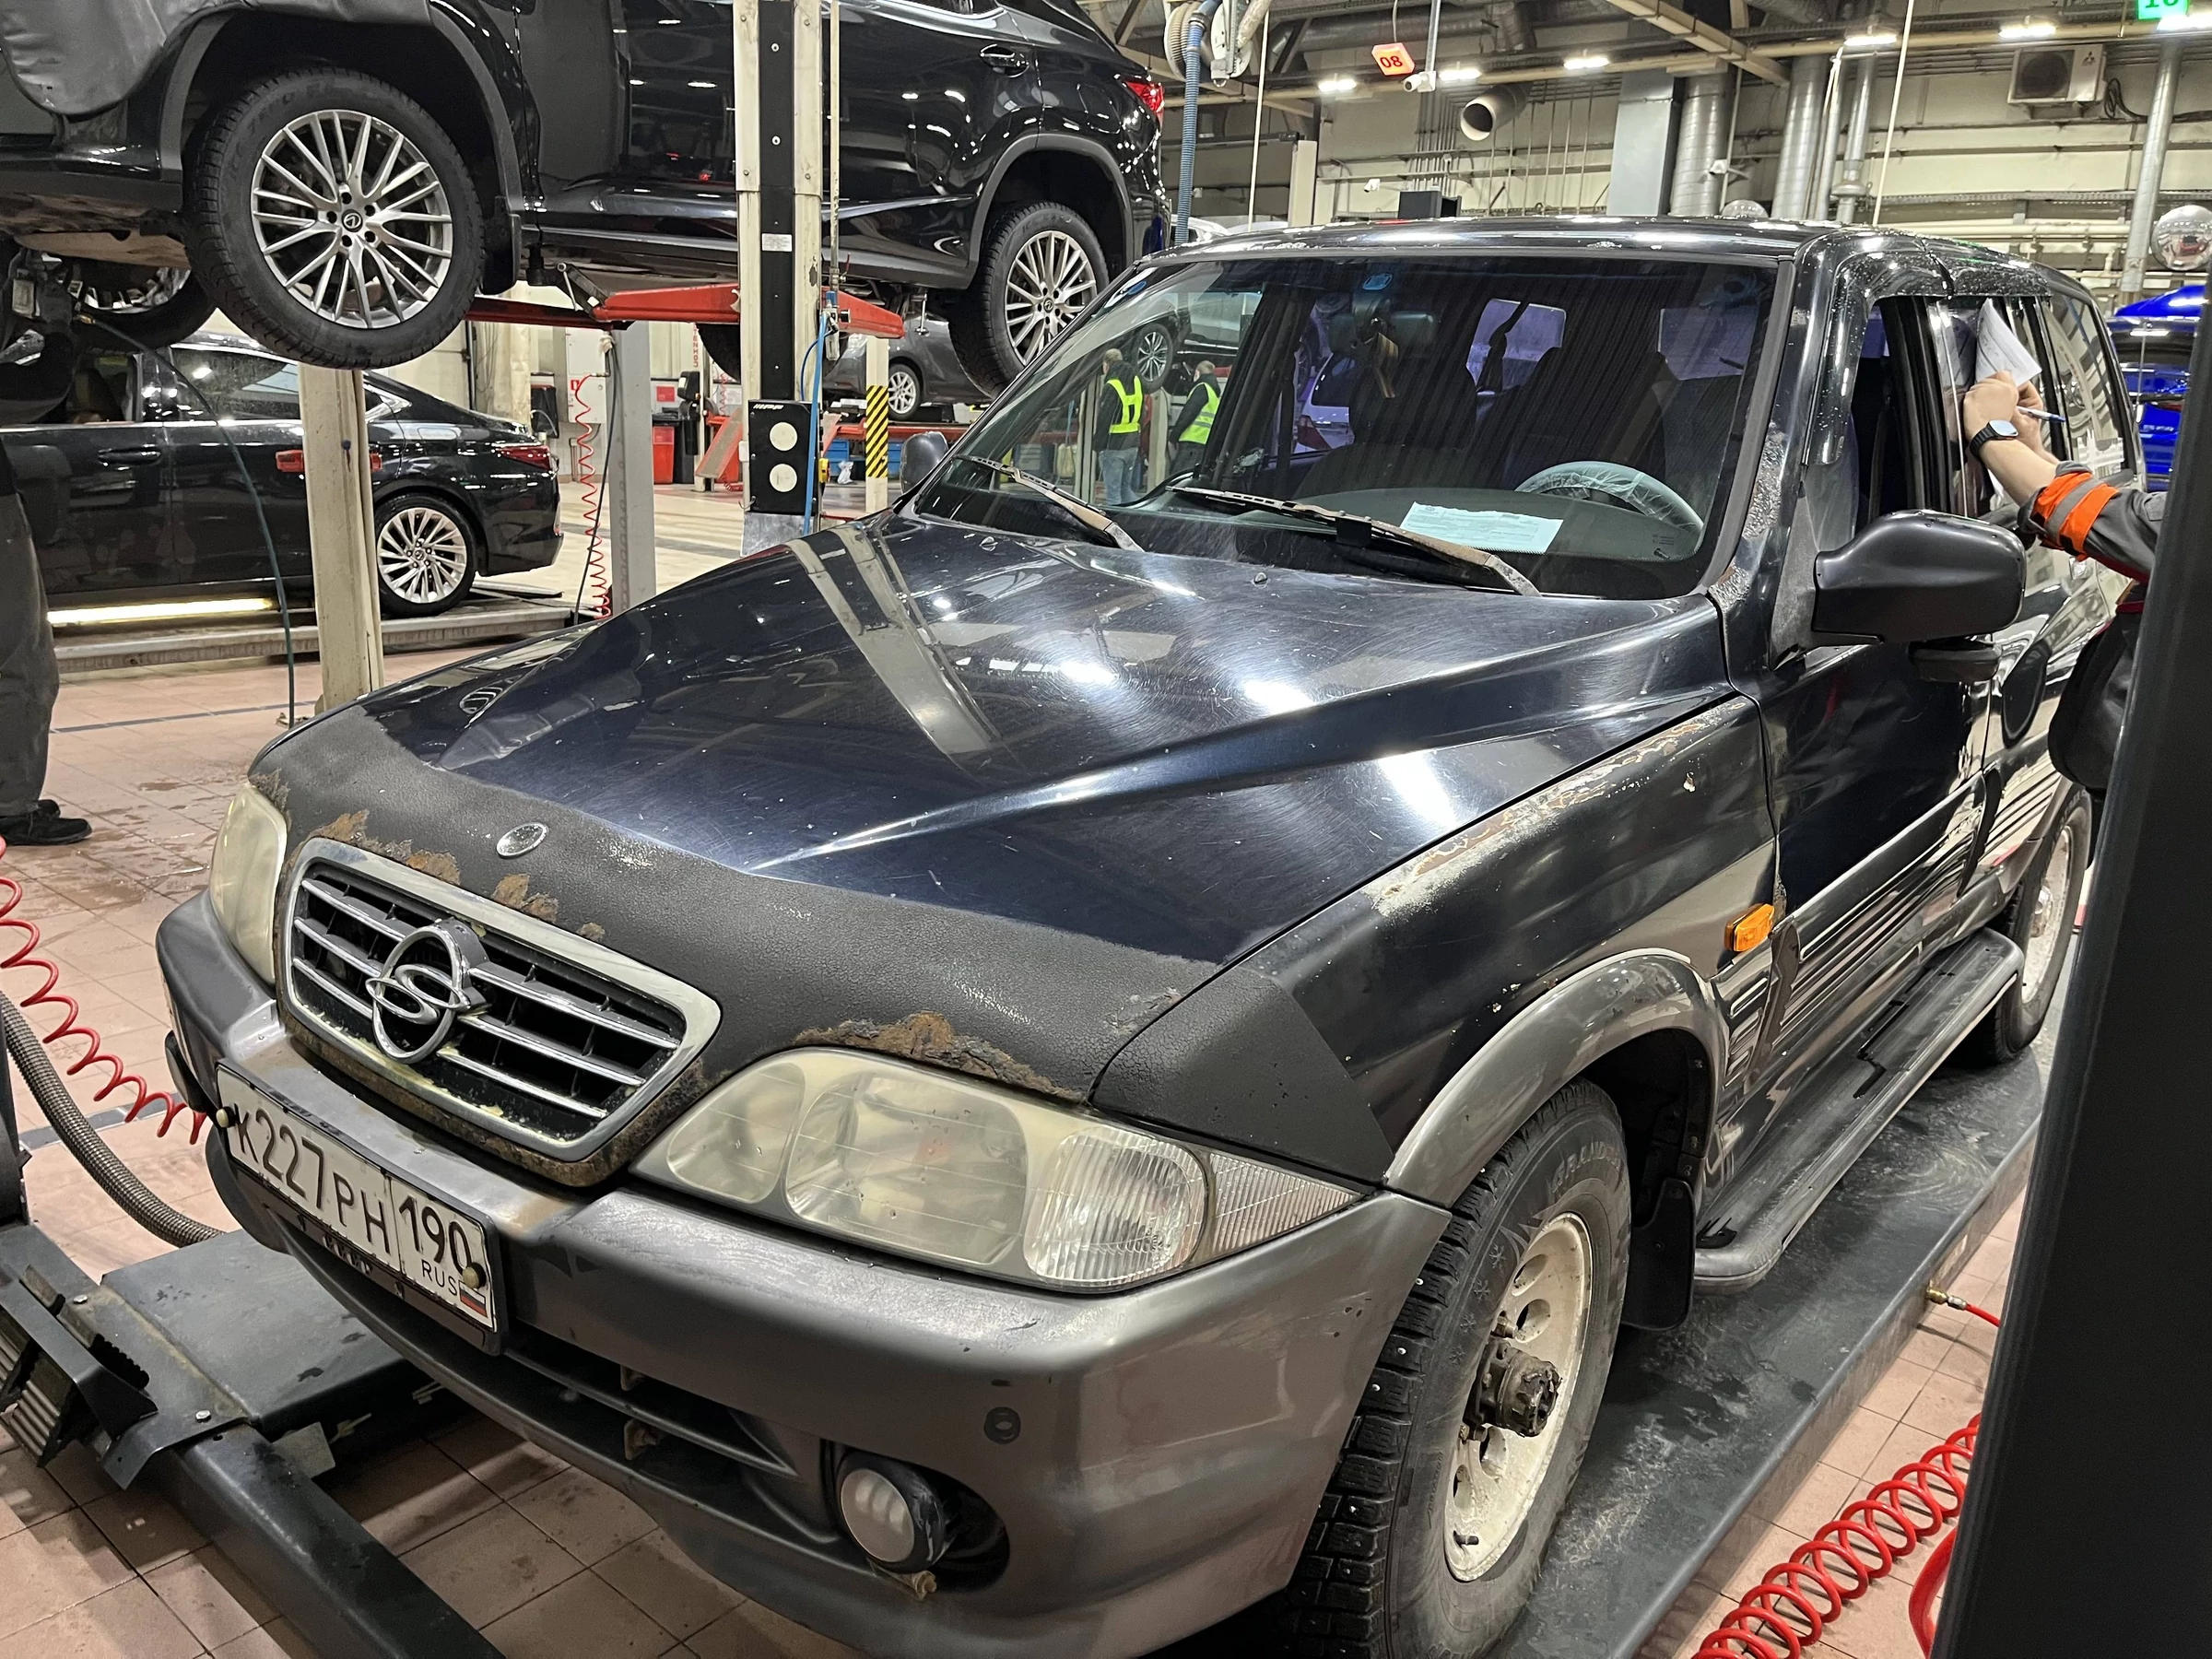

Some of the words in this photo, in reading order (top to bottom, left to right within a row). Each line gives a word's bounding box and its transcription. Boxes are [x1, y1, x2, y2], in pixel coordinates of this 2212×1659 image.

[1380, 55, 1403, 68] 08
[398, 1194, 473, 1277] 190
[421, 1258, 458, 1297] RUS
